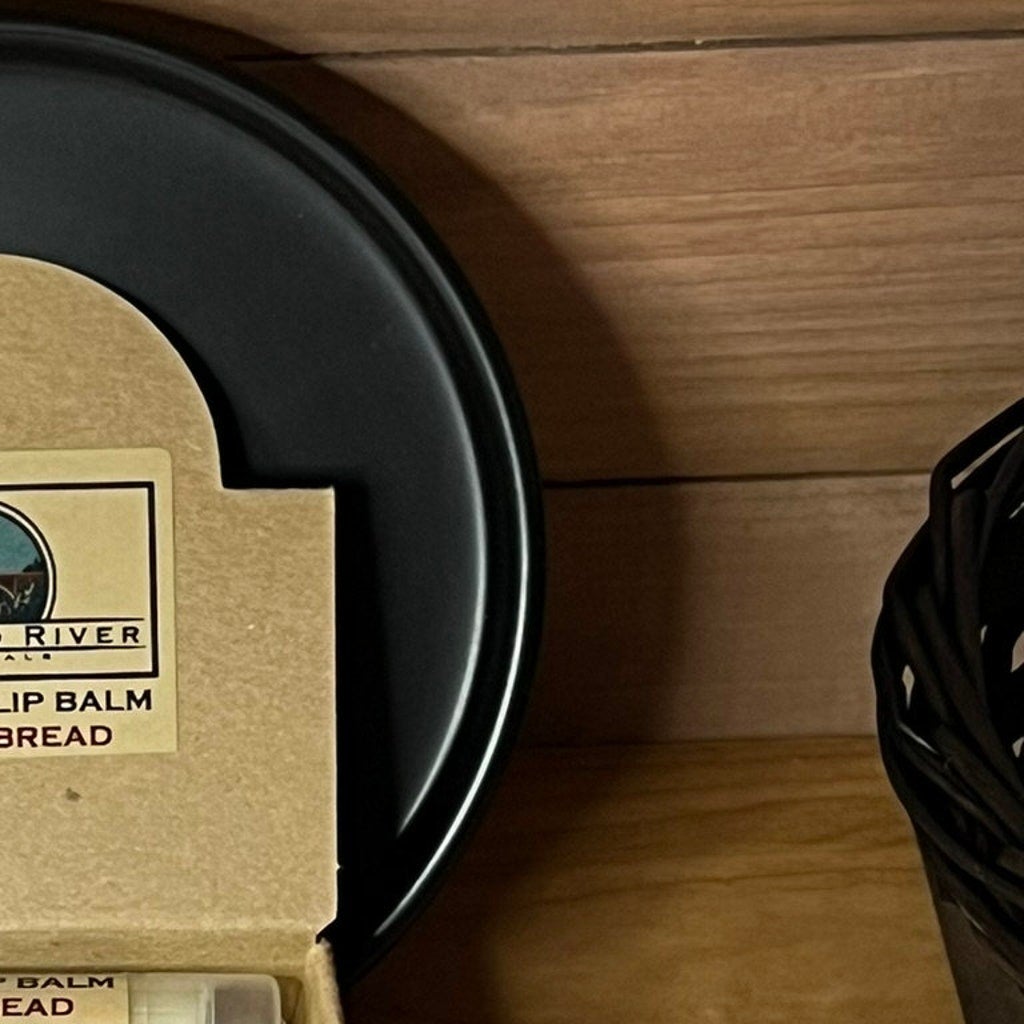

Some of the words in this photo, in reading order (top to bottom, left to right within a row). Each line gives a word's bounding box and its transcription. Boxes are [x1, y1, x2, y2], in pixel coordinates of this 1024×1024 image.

[25, 626, 140, 646] RIVER
[55, 689, 152, 713] BALM
[17, 976, 114, 989] BALM
